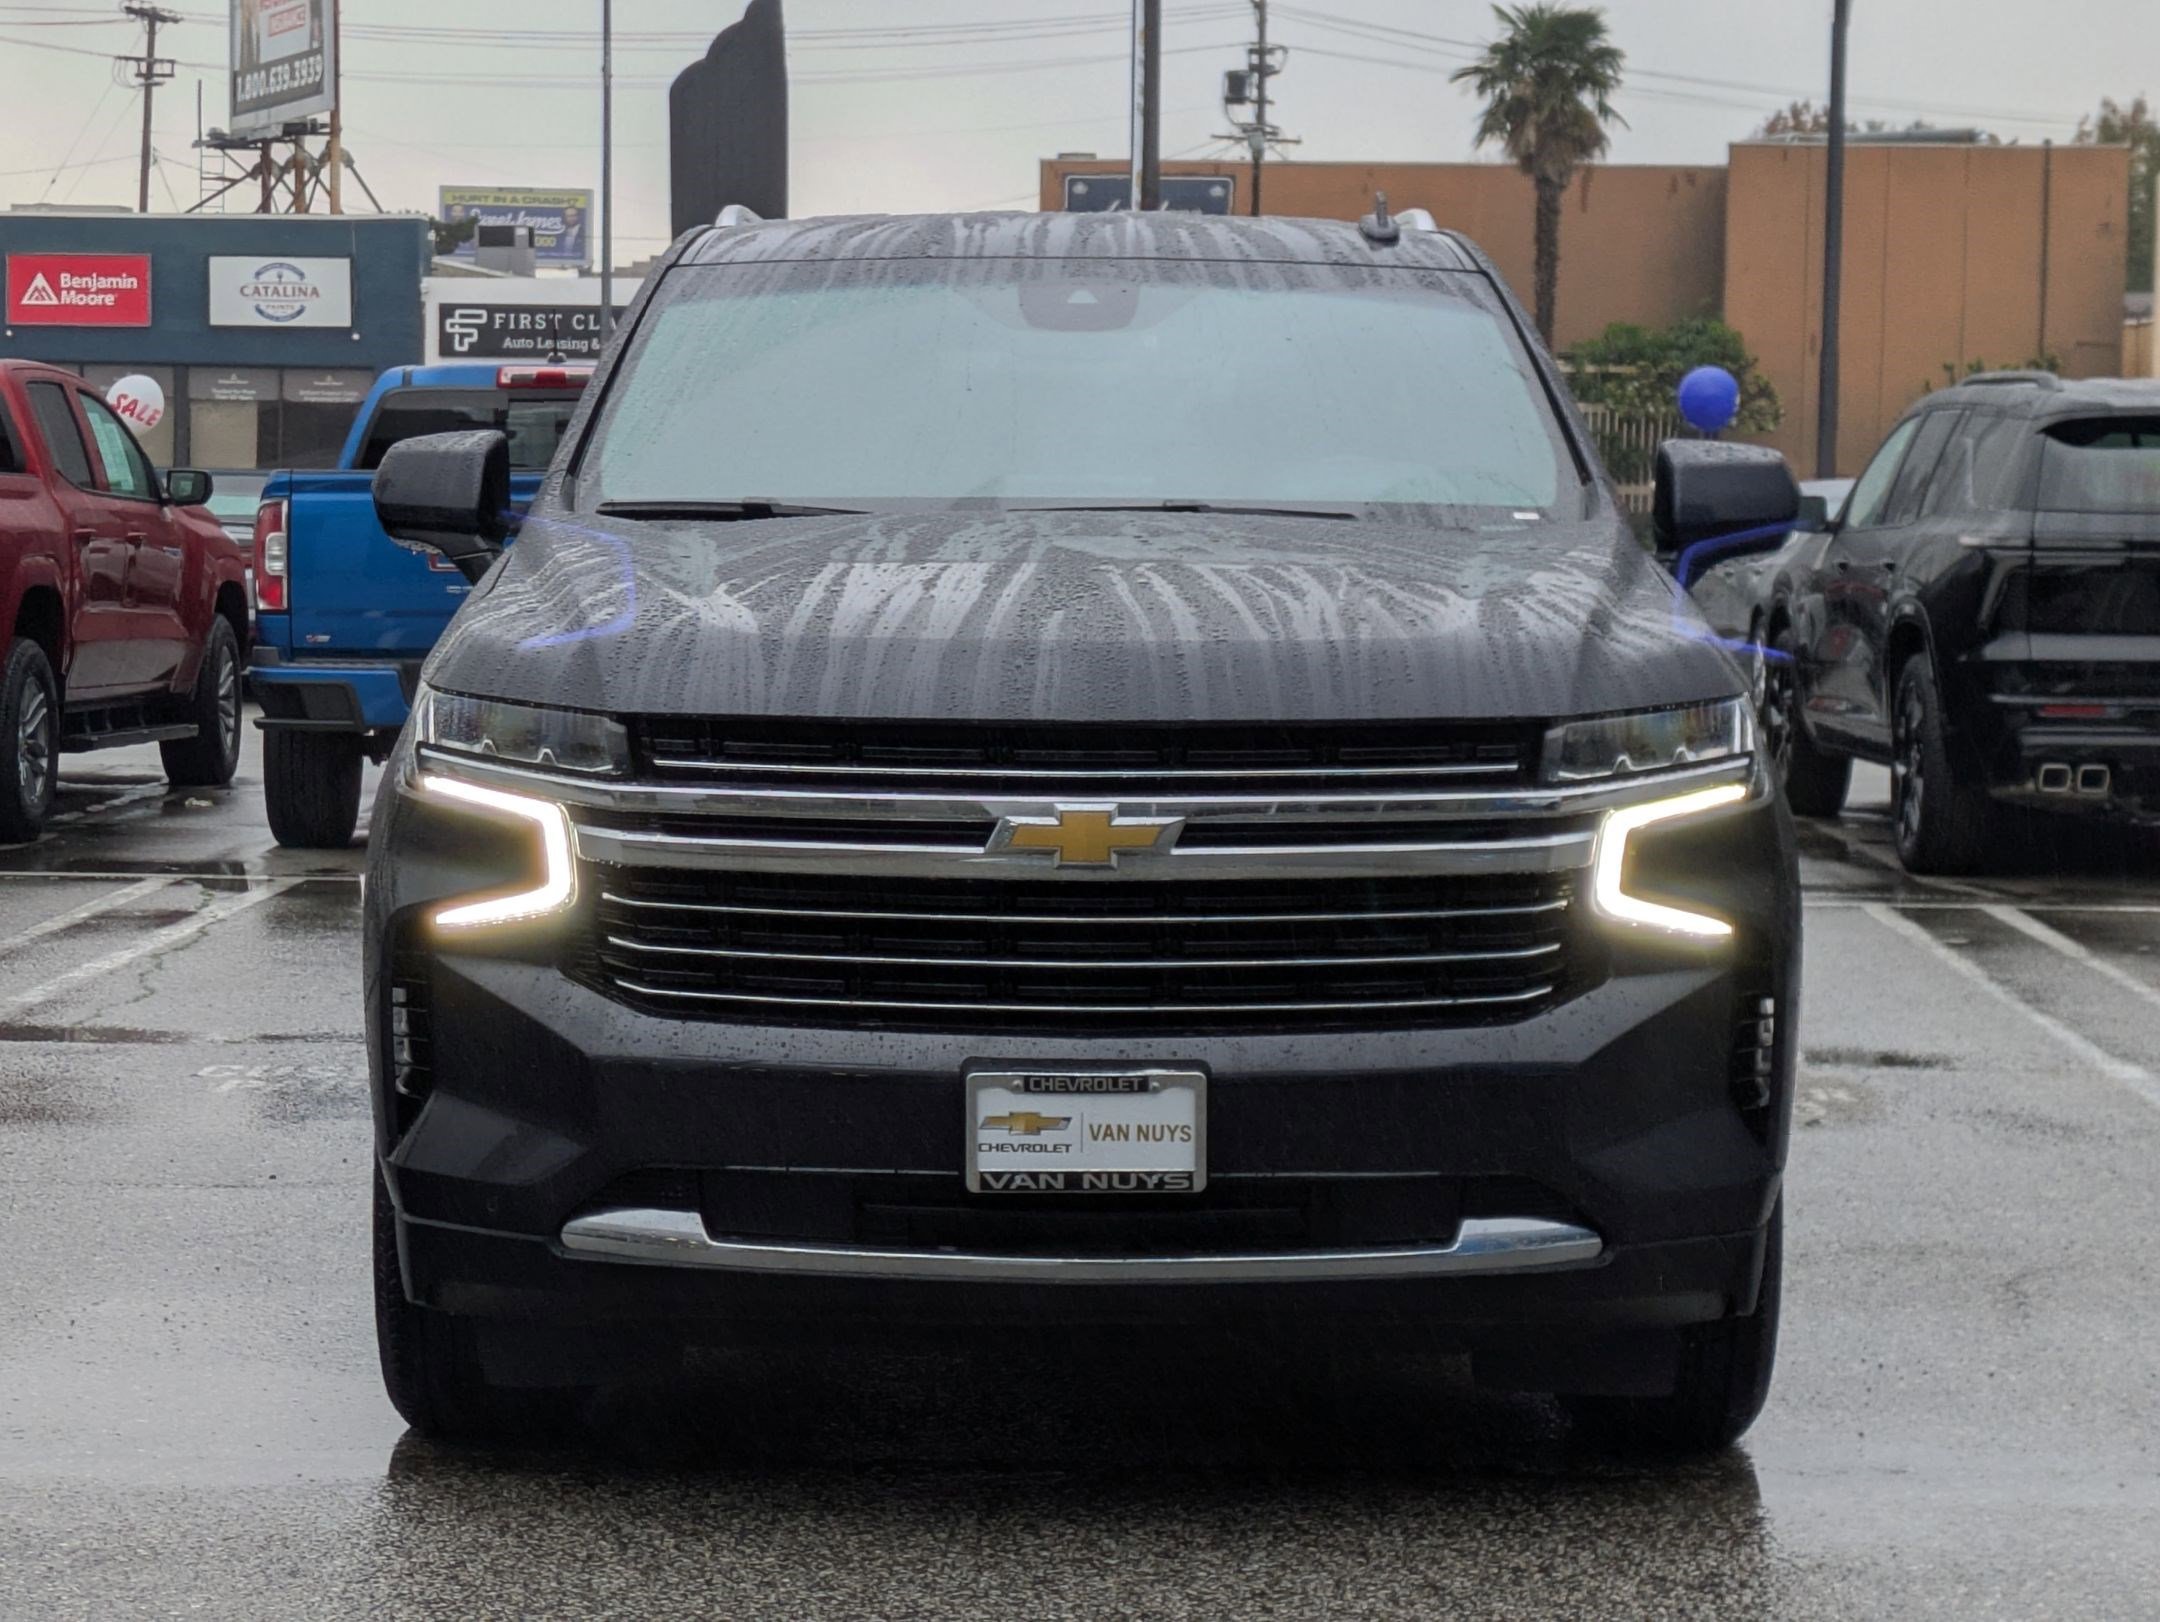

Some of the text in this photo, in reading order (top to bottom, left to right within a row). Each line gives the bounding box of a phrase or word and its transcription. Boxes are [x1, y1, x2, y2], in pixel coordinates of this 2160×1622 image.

[452, 194, 579, 206] HURT IN A CRASH?
[60, 272, 138, 292] Benjamin
[60, 290, 115, 306] Moore
[240, 285, 320, 298] CATALINA
[493, 313, 617, 330] FIRST CL
[503, 337, 535, 350] Auto
[591, 339, 600, 350] &
[112, 393, 161, 427] SALE
[1029, 1077, 1143, 1092] CHEVROLET
[1089, 1123, 1192, 1143] VAN NUYS
[978, 1143, 1072, 1154] CHEVROLET
[983, 1173, 1191, 1190] VAN NUYS
